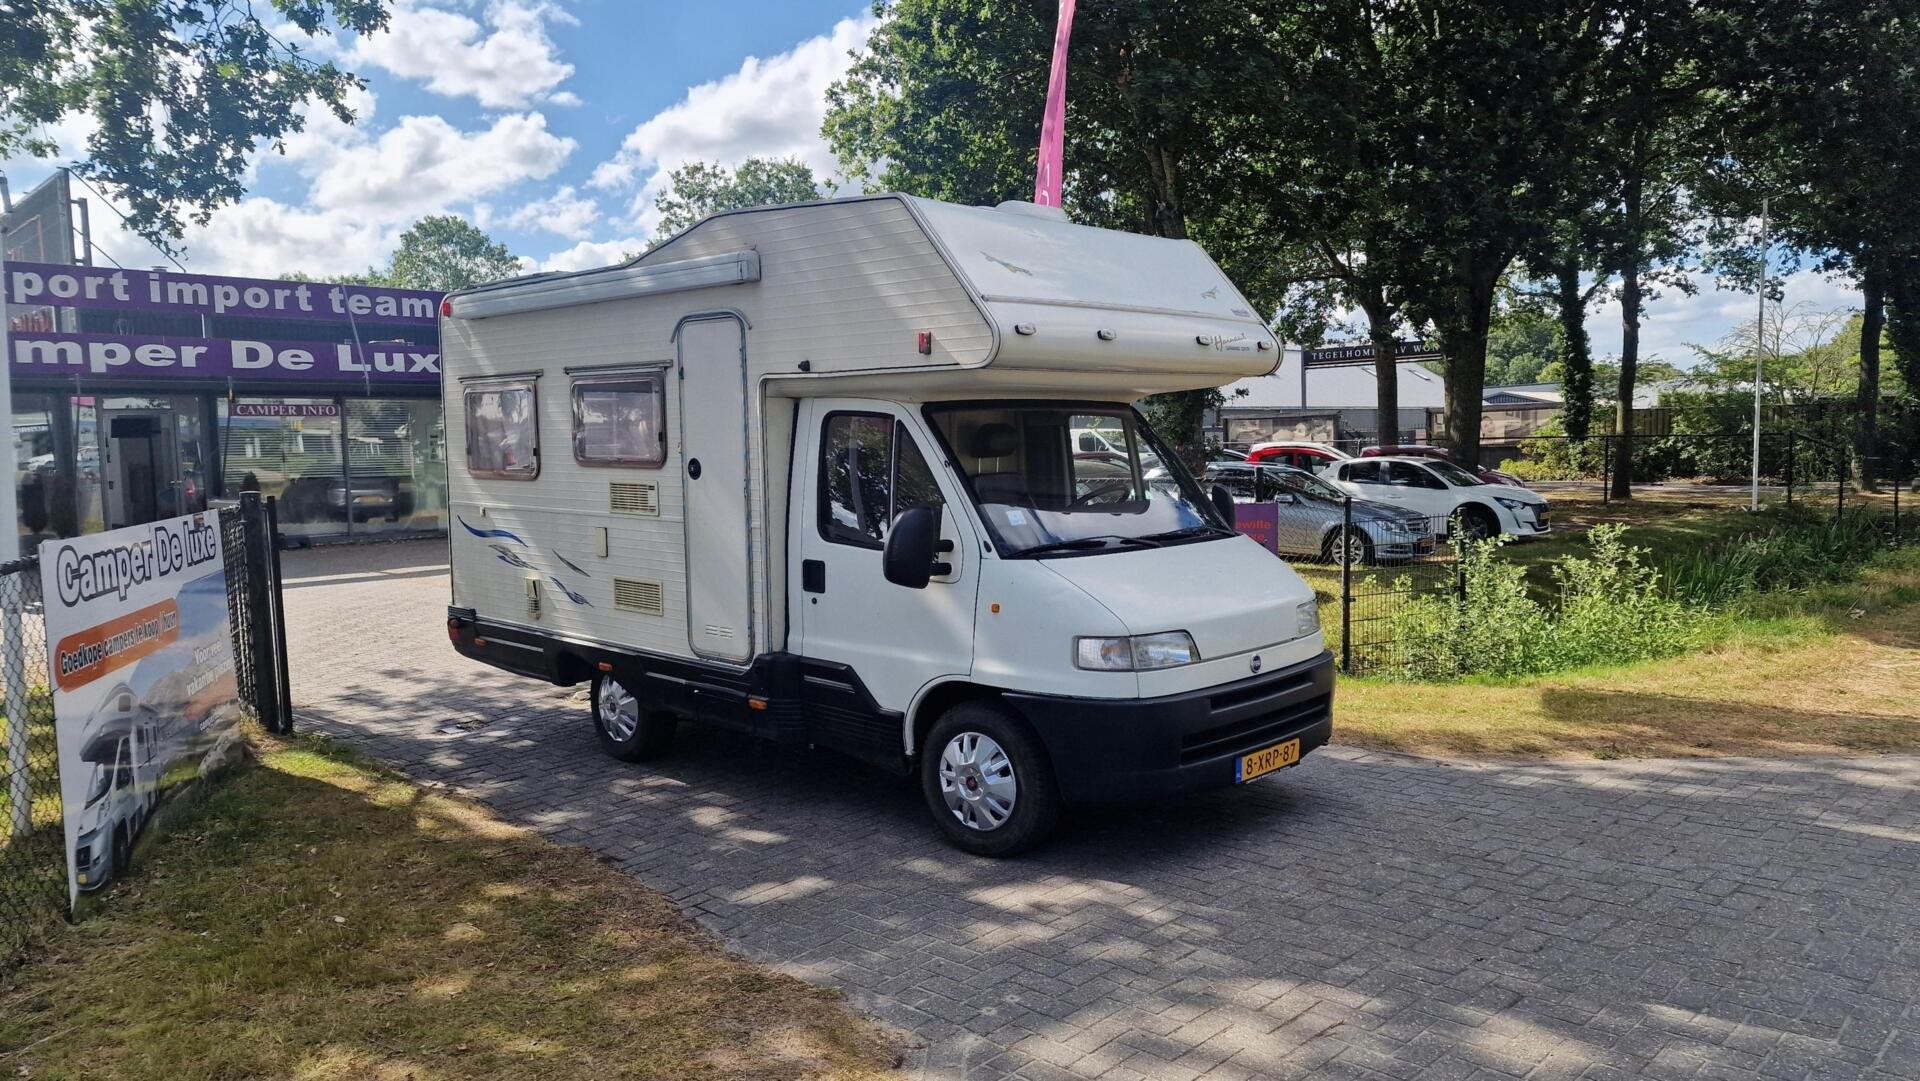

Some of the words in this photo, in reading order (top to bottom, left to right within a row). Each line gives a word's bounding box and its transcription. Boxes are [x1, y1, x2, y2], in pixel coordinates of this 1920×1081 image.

[149, 273, 313, 314] import
[328, 286, 434, 319] team
[231, 340, 315, 371] De
[236, 405, 297, 415] CAMPER
[302, 405, 336, 415] INFO
[57, 539, 152, 607] Camper
[155, 526, 183, 576] De
[60, 642, 103, 676] Goedkope
[103, 628, 137, 658] campers
[143, 618, 160, 642] koop
[1246, 742, 1296, 775] 8-XRP-87
